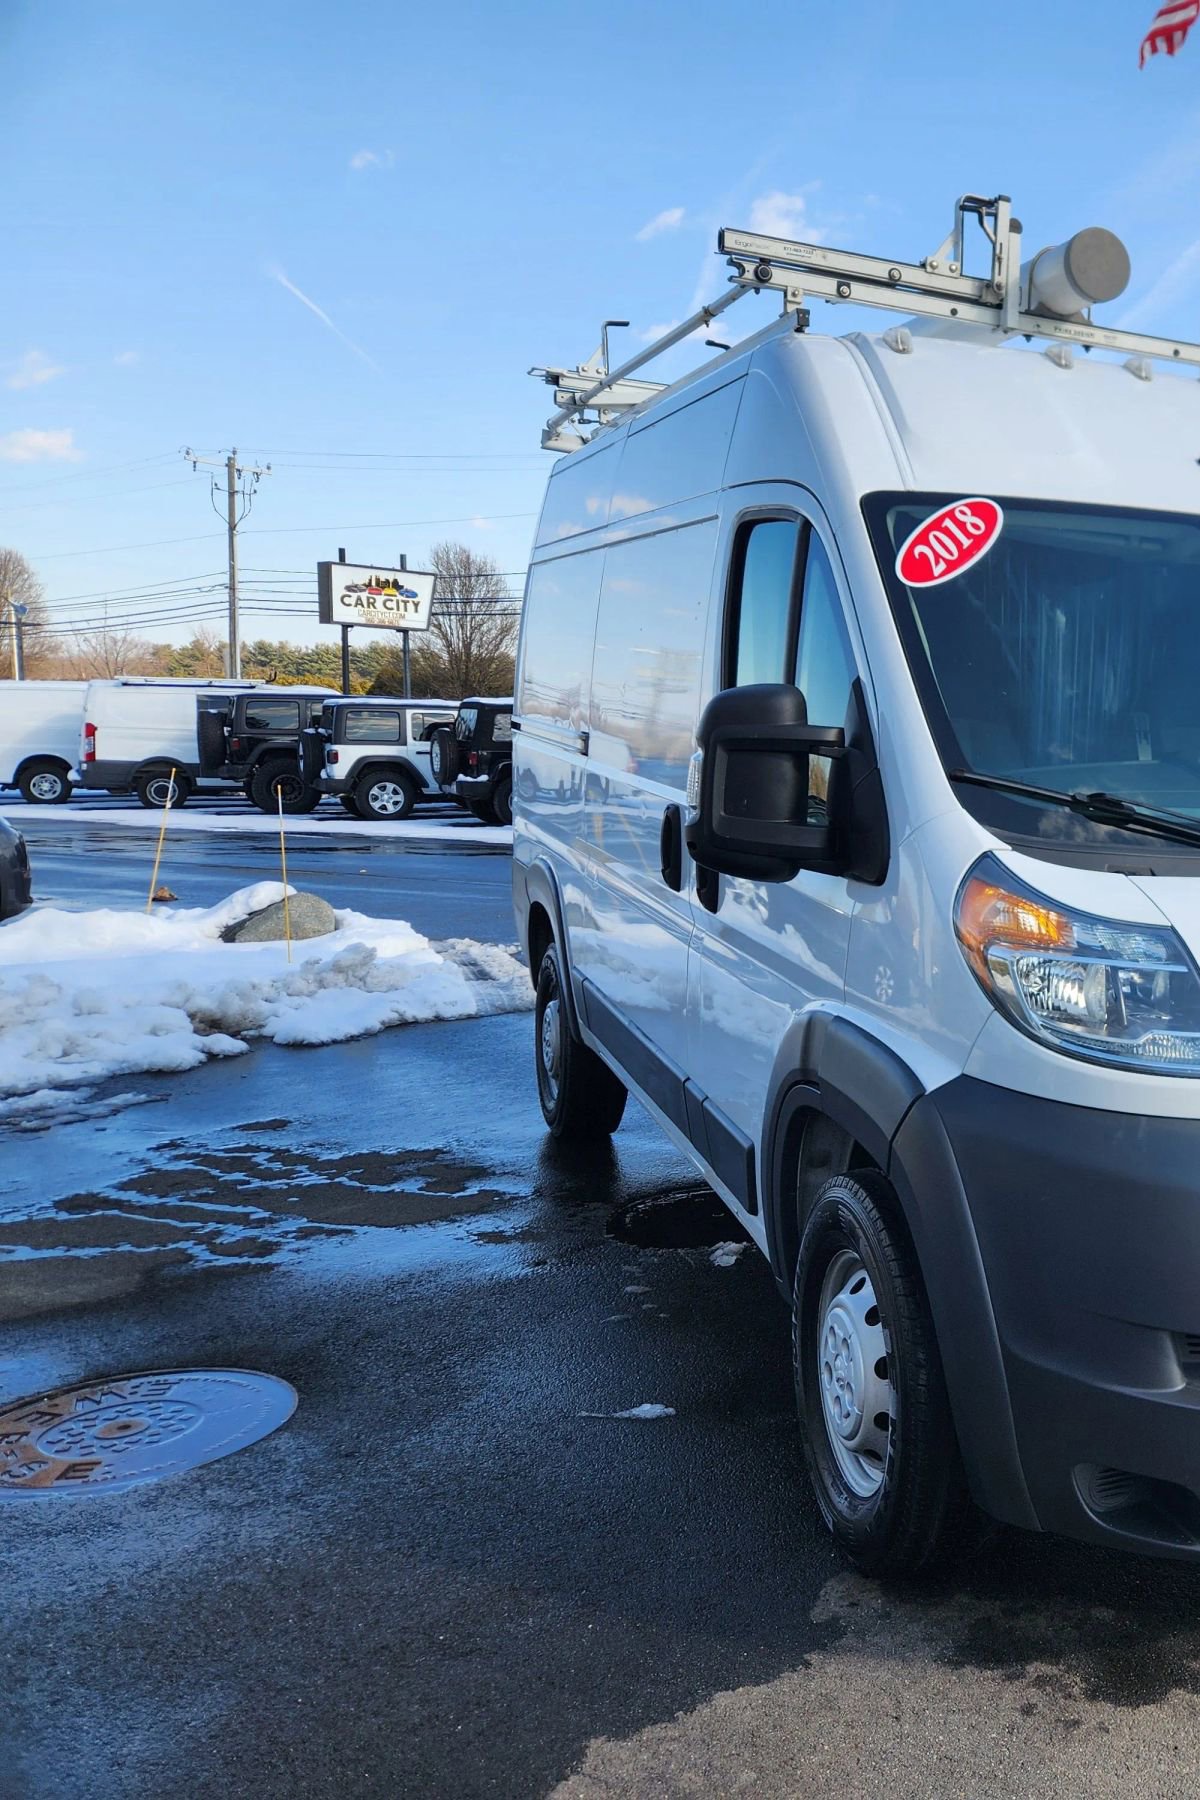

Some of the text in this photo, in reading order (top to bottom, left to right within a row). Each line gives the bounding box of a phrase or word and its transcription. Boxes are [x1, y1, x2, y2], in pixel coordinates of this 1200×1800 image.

[913, 505, 986, 578] 2018
[340, 593, 421, 614] CAR CITY
